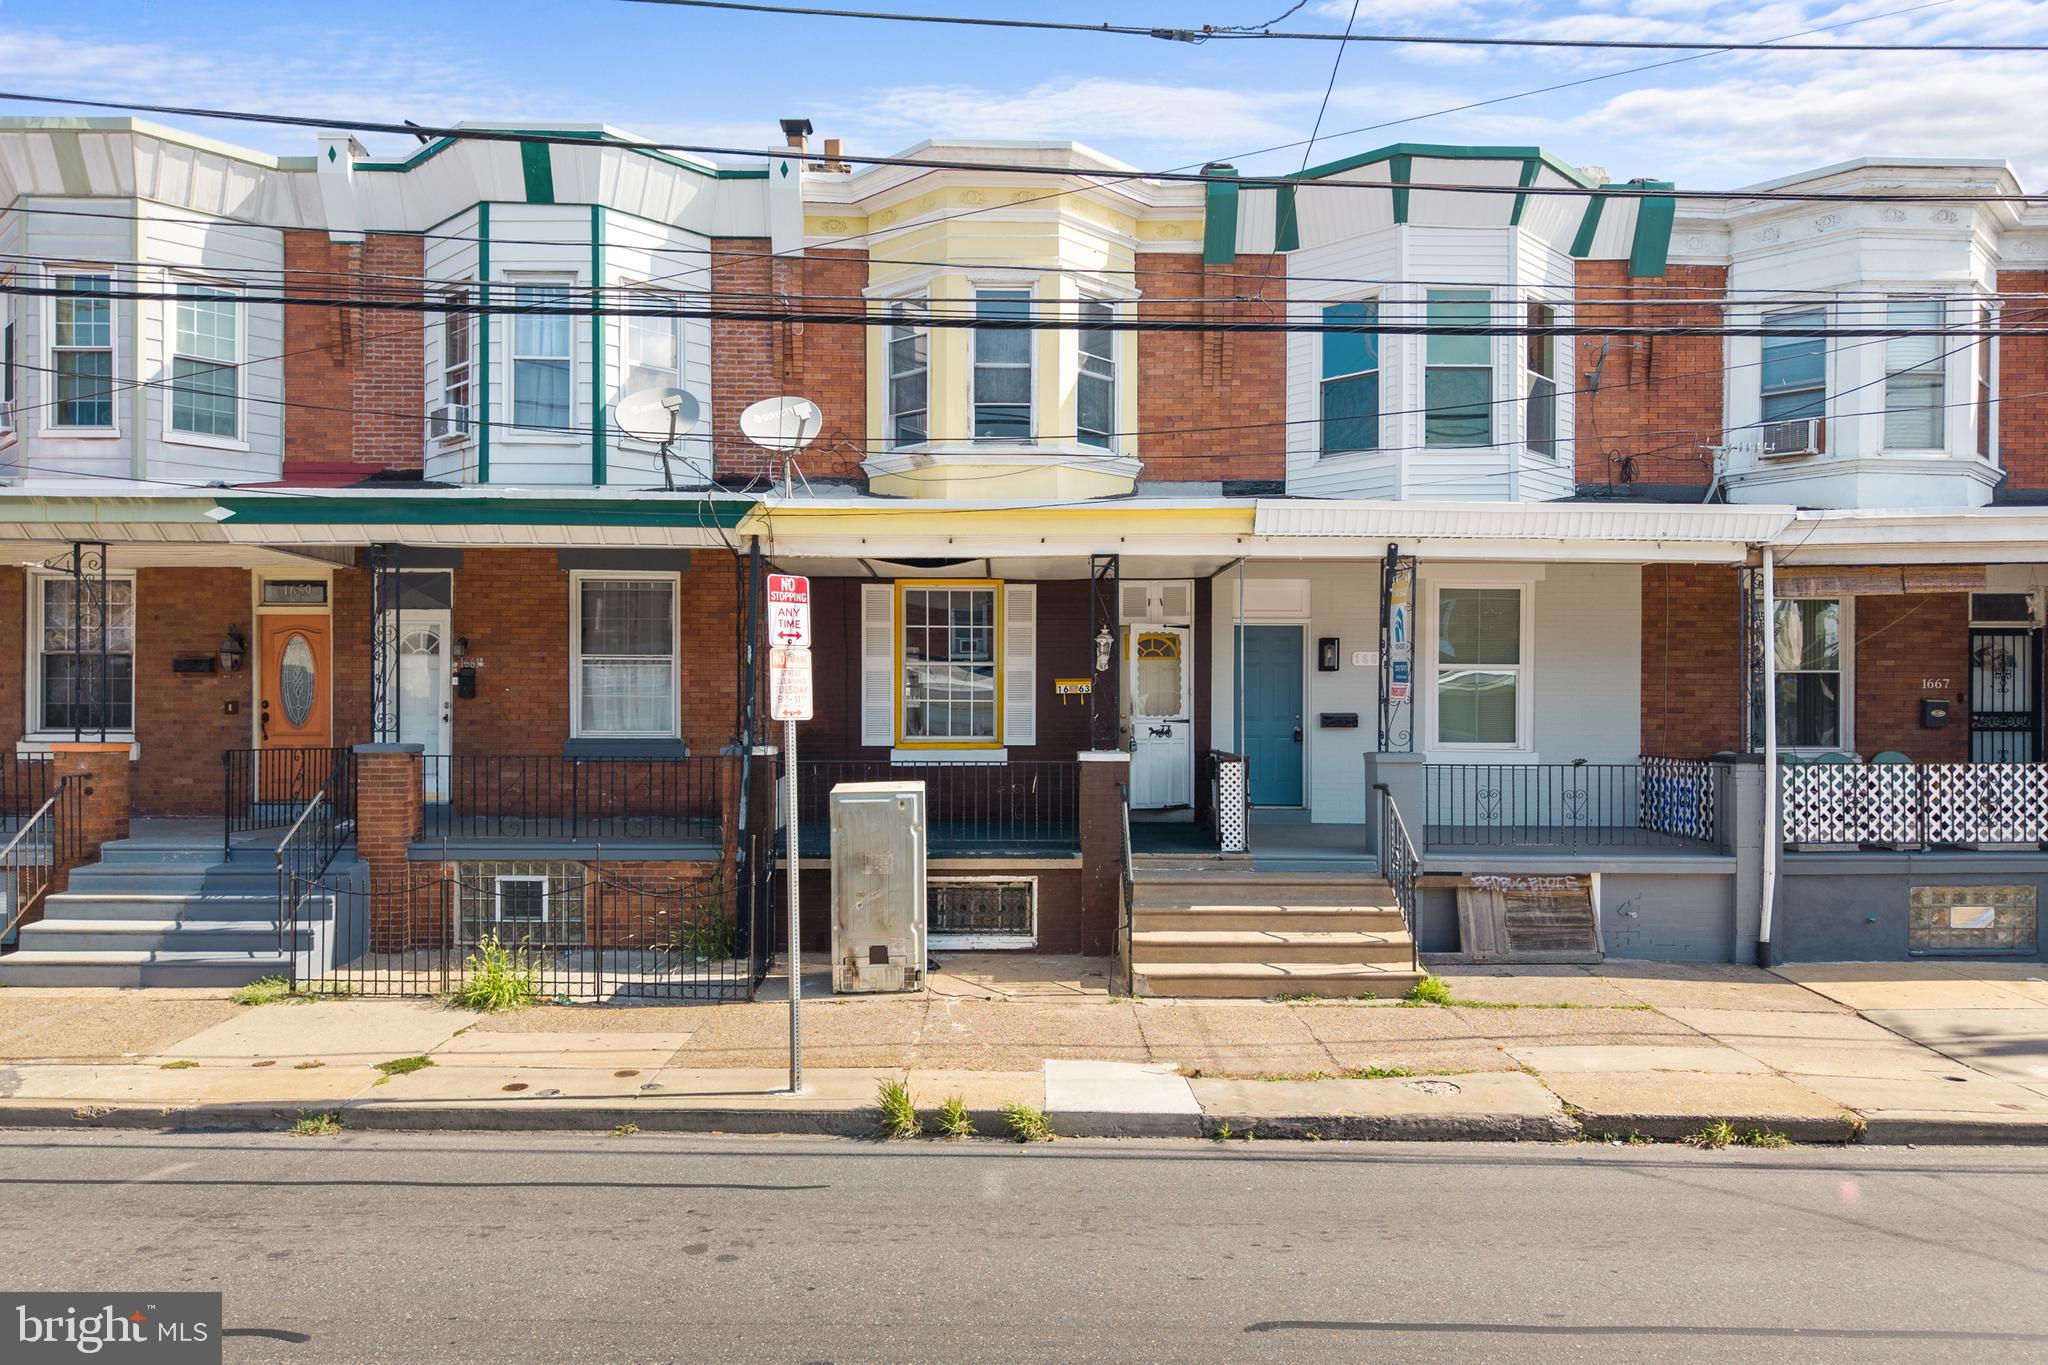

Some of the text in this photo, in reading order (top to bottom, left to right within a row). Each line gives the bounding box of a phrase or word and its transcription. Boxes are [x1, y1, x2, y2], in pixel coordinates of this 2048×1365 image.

[781, 577, 796, 592] NO
[284, 584, 312, 598] 1659
[770, 591, 807, 603] STOPPING
[778, 608, 800, 617] ANY
[778, 619, 801, 629] TIME
[773, 651, 786, 666] NO
[1922, 678, 1950, 689] 1667
[776, 685, 808, 695] TUESDAY
